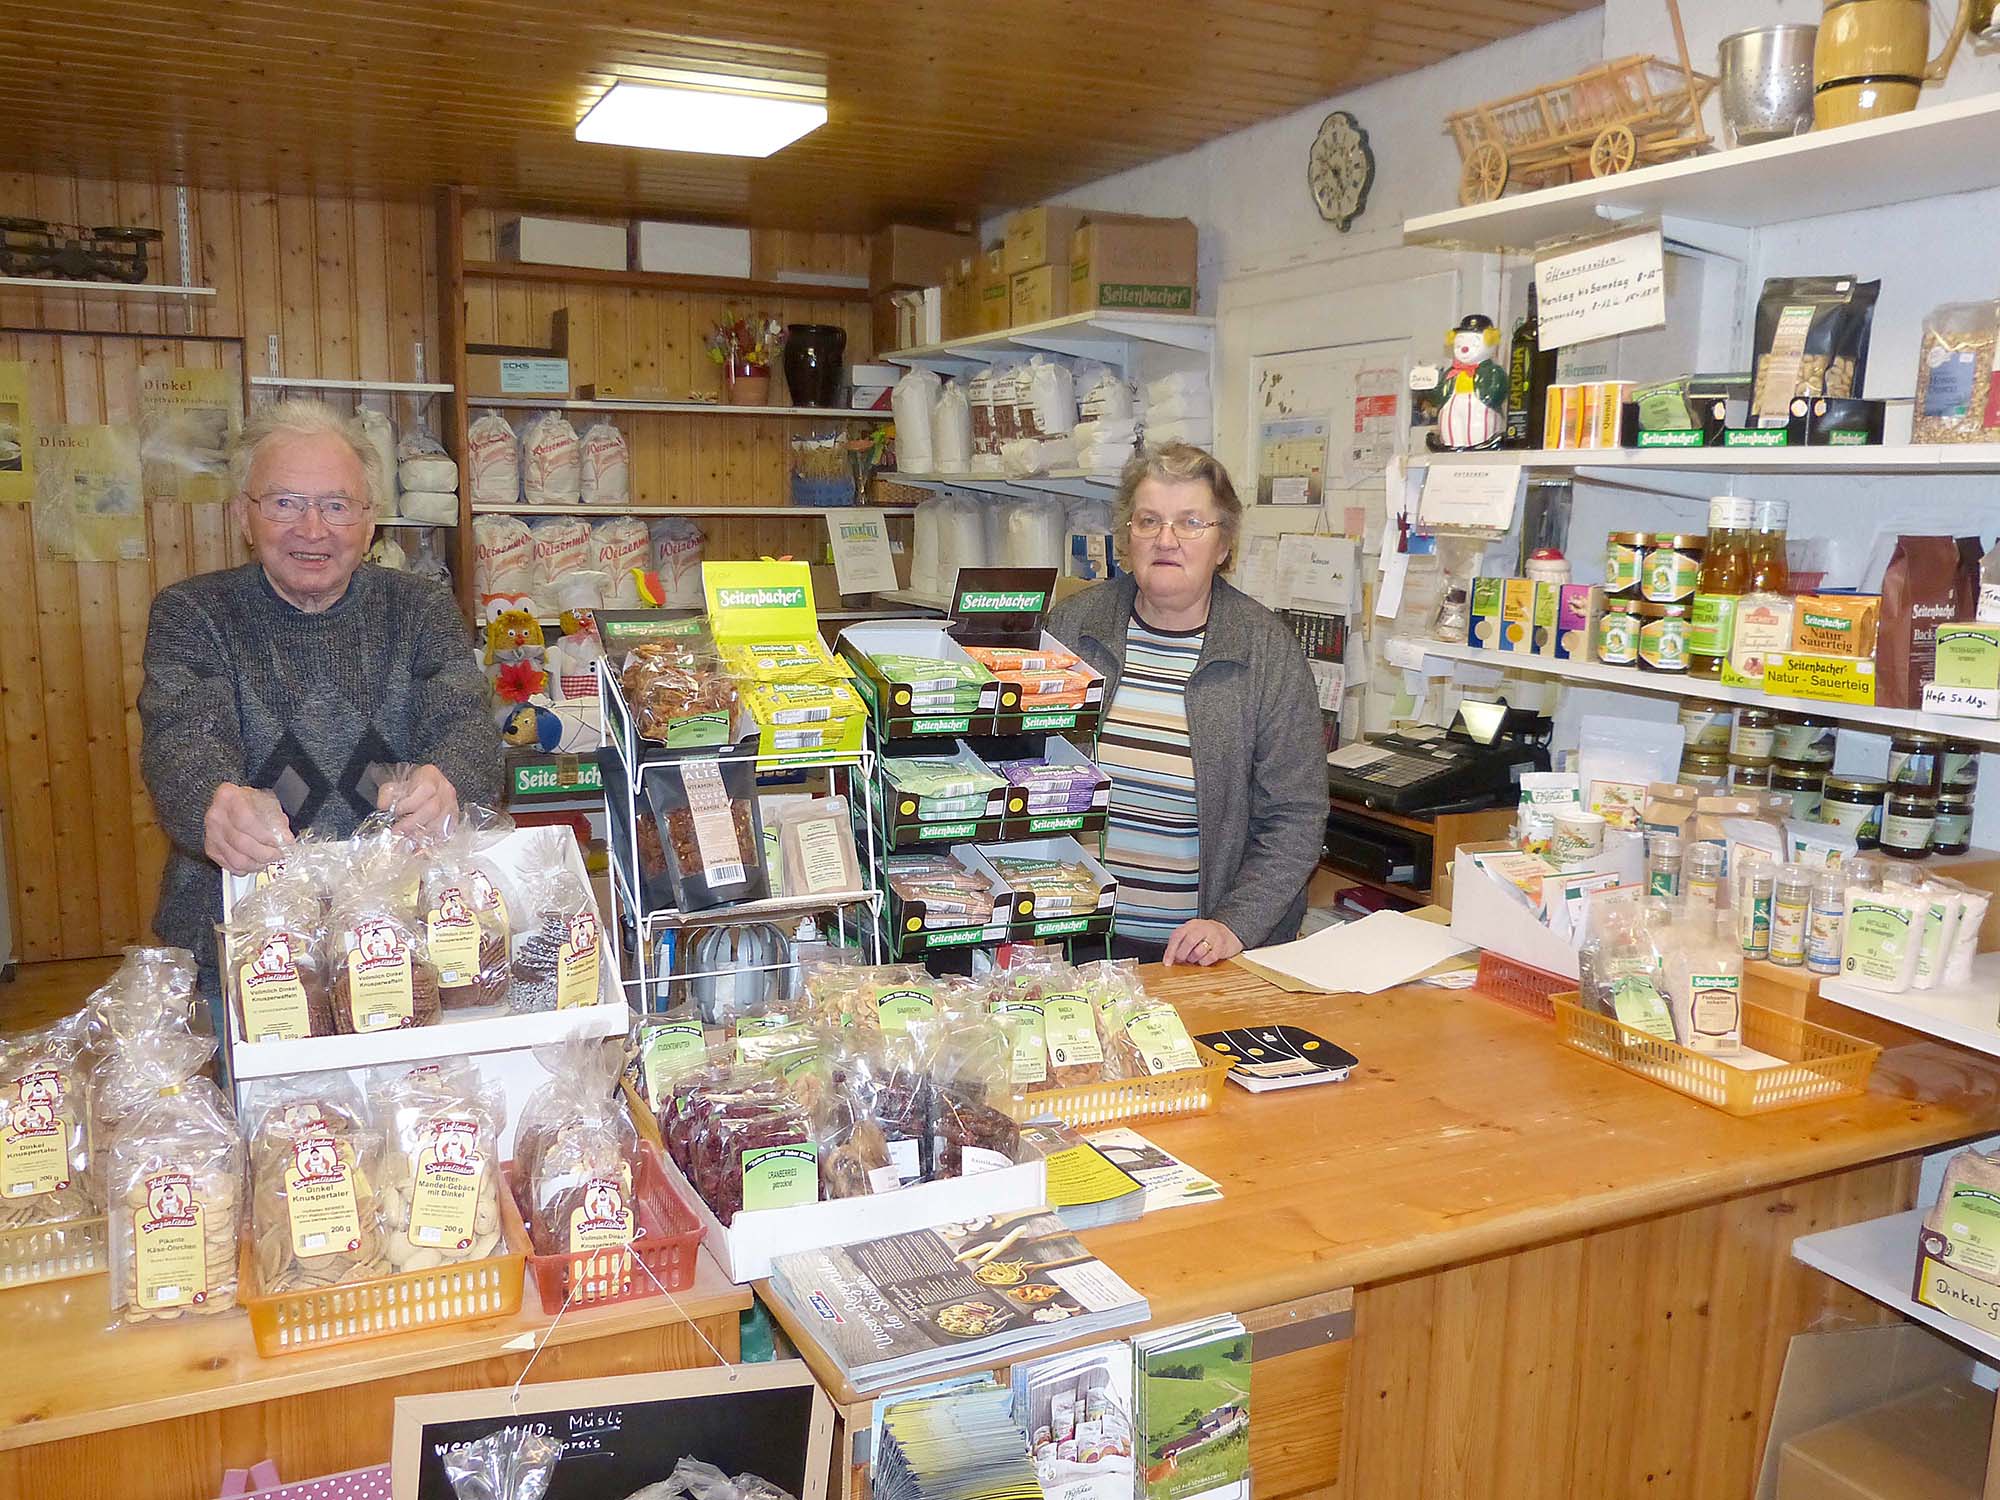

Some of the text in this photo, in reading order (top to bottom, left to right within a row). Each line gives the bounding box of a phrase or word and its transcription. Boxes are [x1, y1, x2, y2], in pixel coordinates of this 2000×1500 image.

[1102, 286, 1187, 307] Seitenbacher
[144, 380, 193, 391] Dinkel
[40, 436, 90, 448] Dinkel
[1642, 432, 1699, 447] Seitenbacher
[1728, 431, 1782, 447] Seitenbacher
[720, 588, 801, 610] Seitenbacher
[961, 592, 1041, 613] Seitenbacher
[1912, 603, 1955, 620] Seitenbacher
[1805, 614, 1849, 631] Seitenbacher
[1810, 627, 1845, 640] Natur
[1799, 634, 1853, 654] Sauerteig
[1787, 659, 1847, 676] Seitenbacher
[1767, 671, 1799, 684] Natur
[1810, 675, 1870, 694] Sauerteig
[1925, 689, 1946, 703] Hefe
[914, 719, 968, 734] Seitenbacher
[1022, 716, 1076, 732] Seitenbacher
[685, 770, 720, 781] ALIS
[922, 825, 975, 840] Seitenbacher
[1031, 818, 1084, 835] Seitenbacher
[1037, 920, 1088, 937] Seitenbacher
[929, 930, 982, 947] Seitenbacher
[358, 973, 385, 981] Vollmilch
[359, 978, 404, 988] Knusperwaffeln
[250, 985, 298, 996] Vollmilch Dinkel
[251, 993, 298, 1003] Knusperwaffeln
[7, 1147, 58, 1159] Knuspertaler
[20, 1143, 45, 1151] Dinkel
[298, 1139, 334, 1153] Hofladen
[148, 1176, 190, 1191] Hofladen
[435, 1174, 461, 1183] Butter-
[306, 1184, 334, 1194] Dinkel
[418, 1180, 476, 1192] Mandel-Gebäck
[292, 1191, 349, 1202] Knuspertaler
[427, 1189, 465, 1199] mit Dinkel
[331, 1225, 345, 1233] 200
[444, 1224, 457, 1232] 200
[881, 1310, 906, 1327] der
[569, 1411, 624, 1430] Müsli
